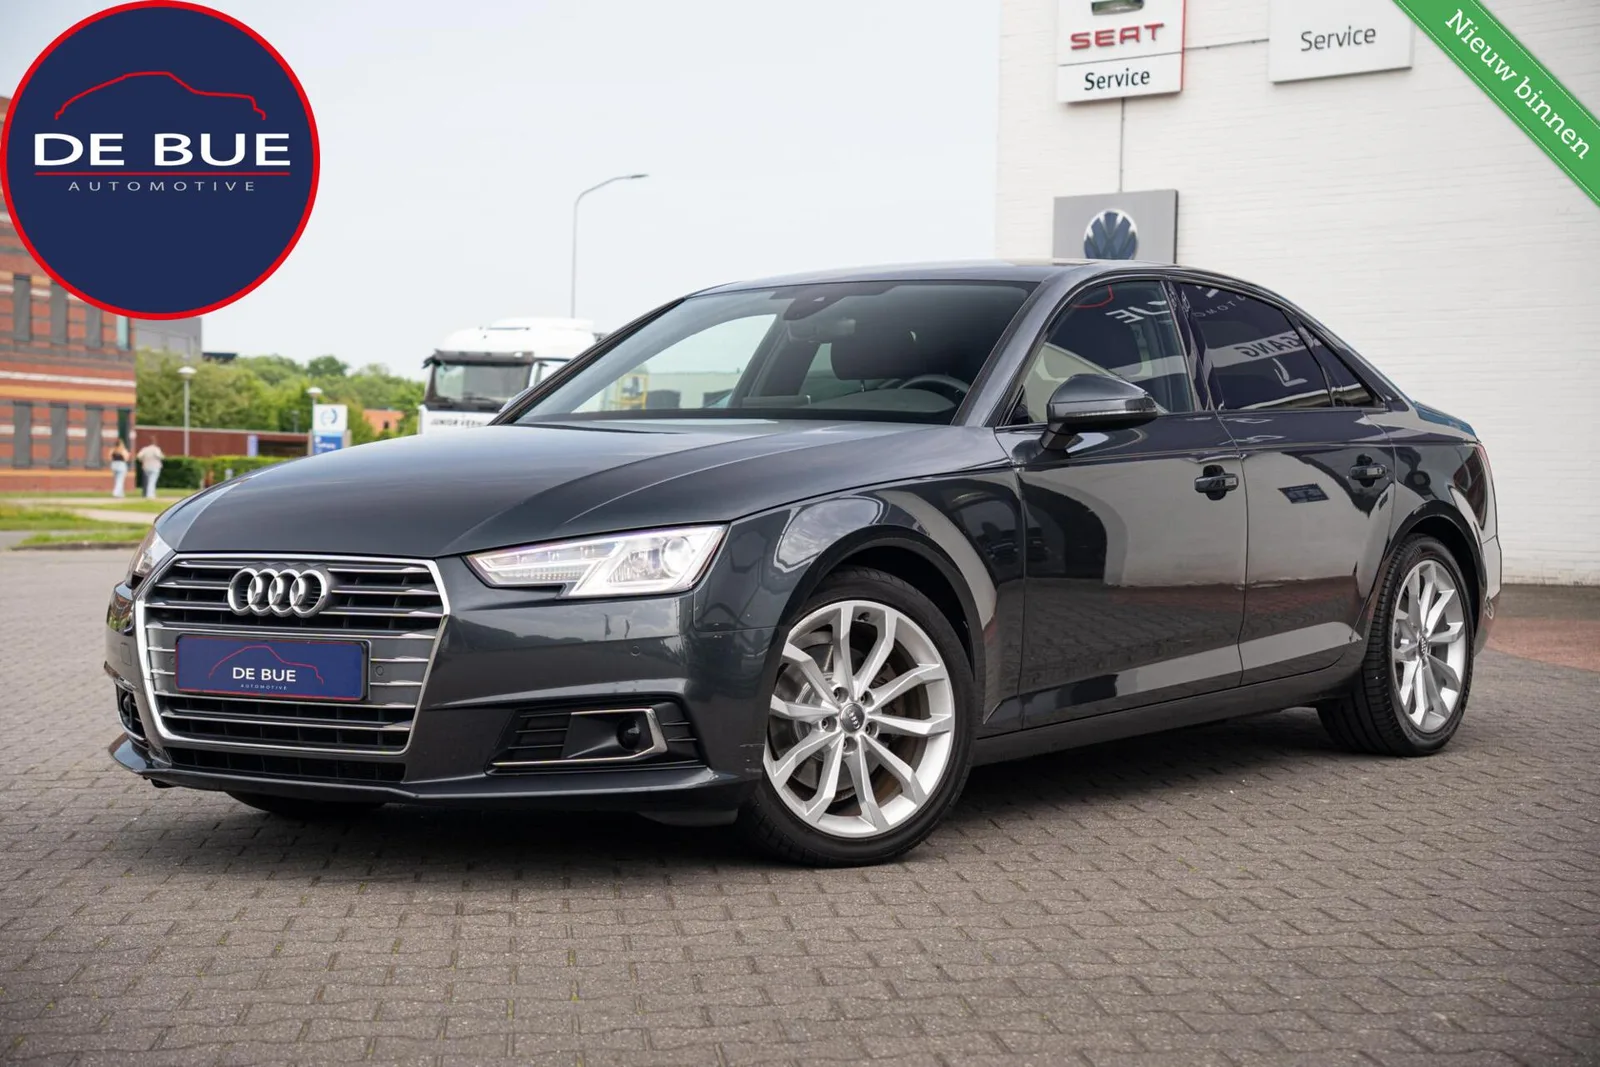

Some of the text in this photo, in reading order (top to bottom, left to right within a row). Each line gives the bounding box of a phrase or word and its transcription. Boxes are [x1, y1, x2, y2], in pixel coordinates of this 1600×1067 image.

[1070, 23, 1165, 50] SEAT
[1300, 25, 1377, 52] Service
[1084, 67, 1151, 91] Service
[232, 667, 297, 682] DE BUE
